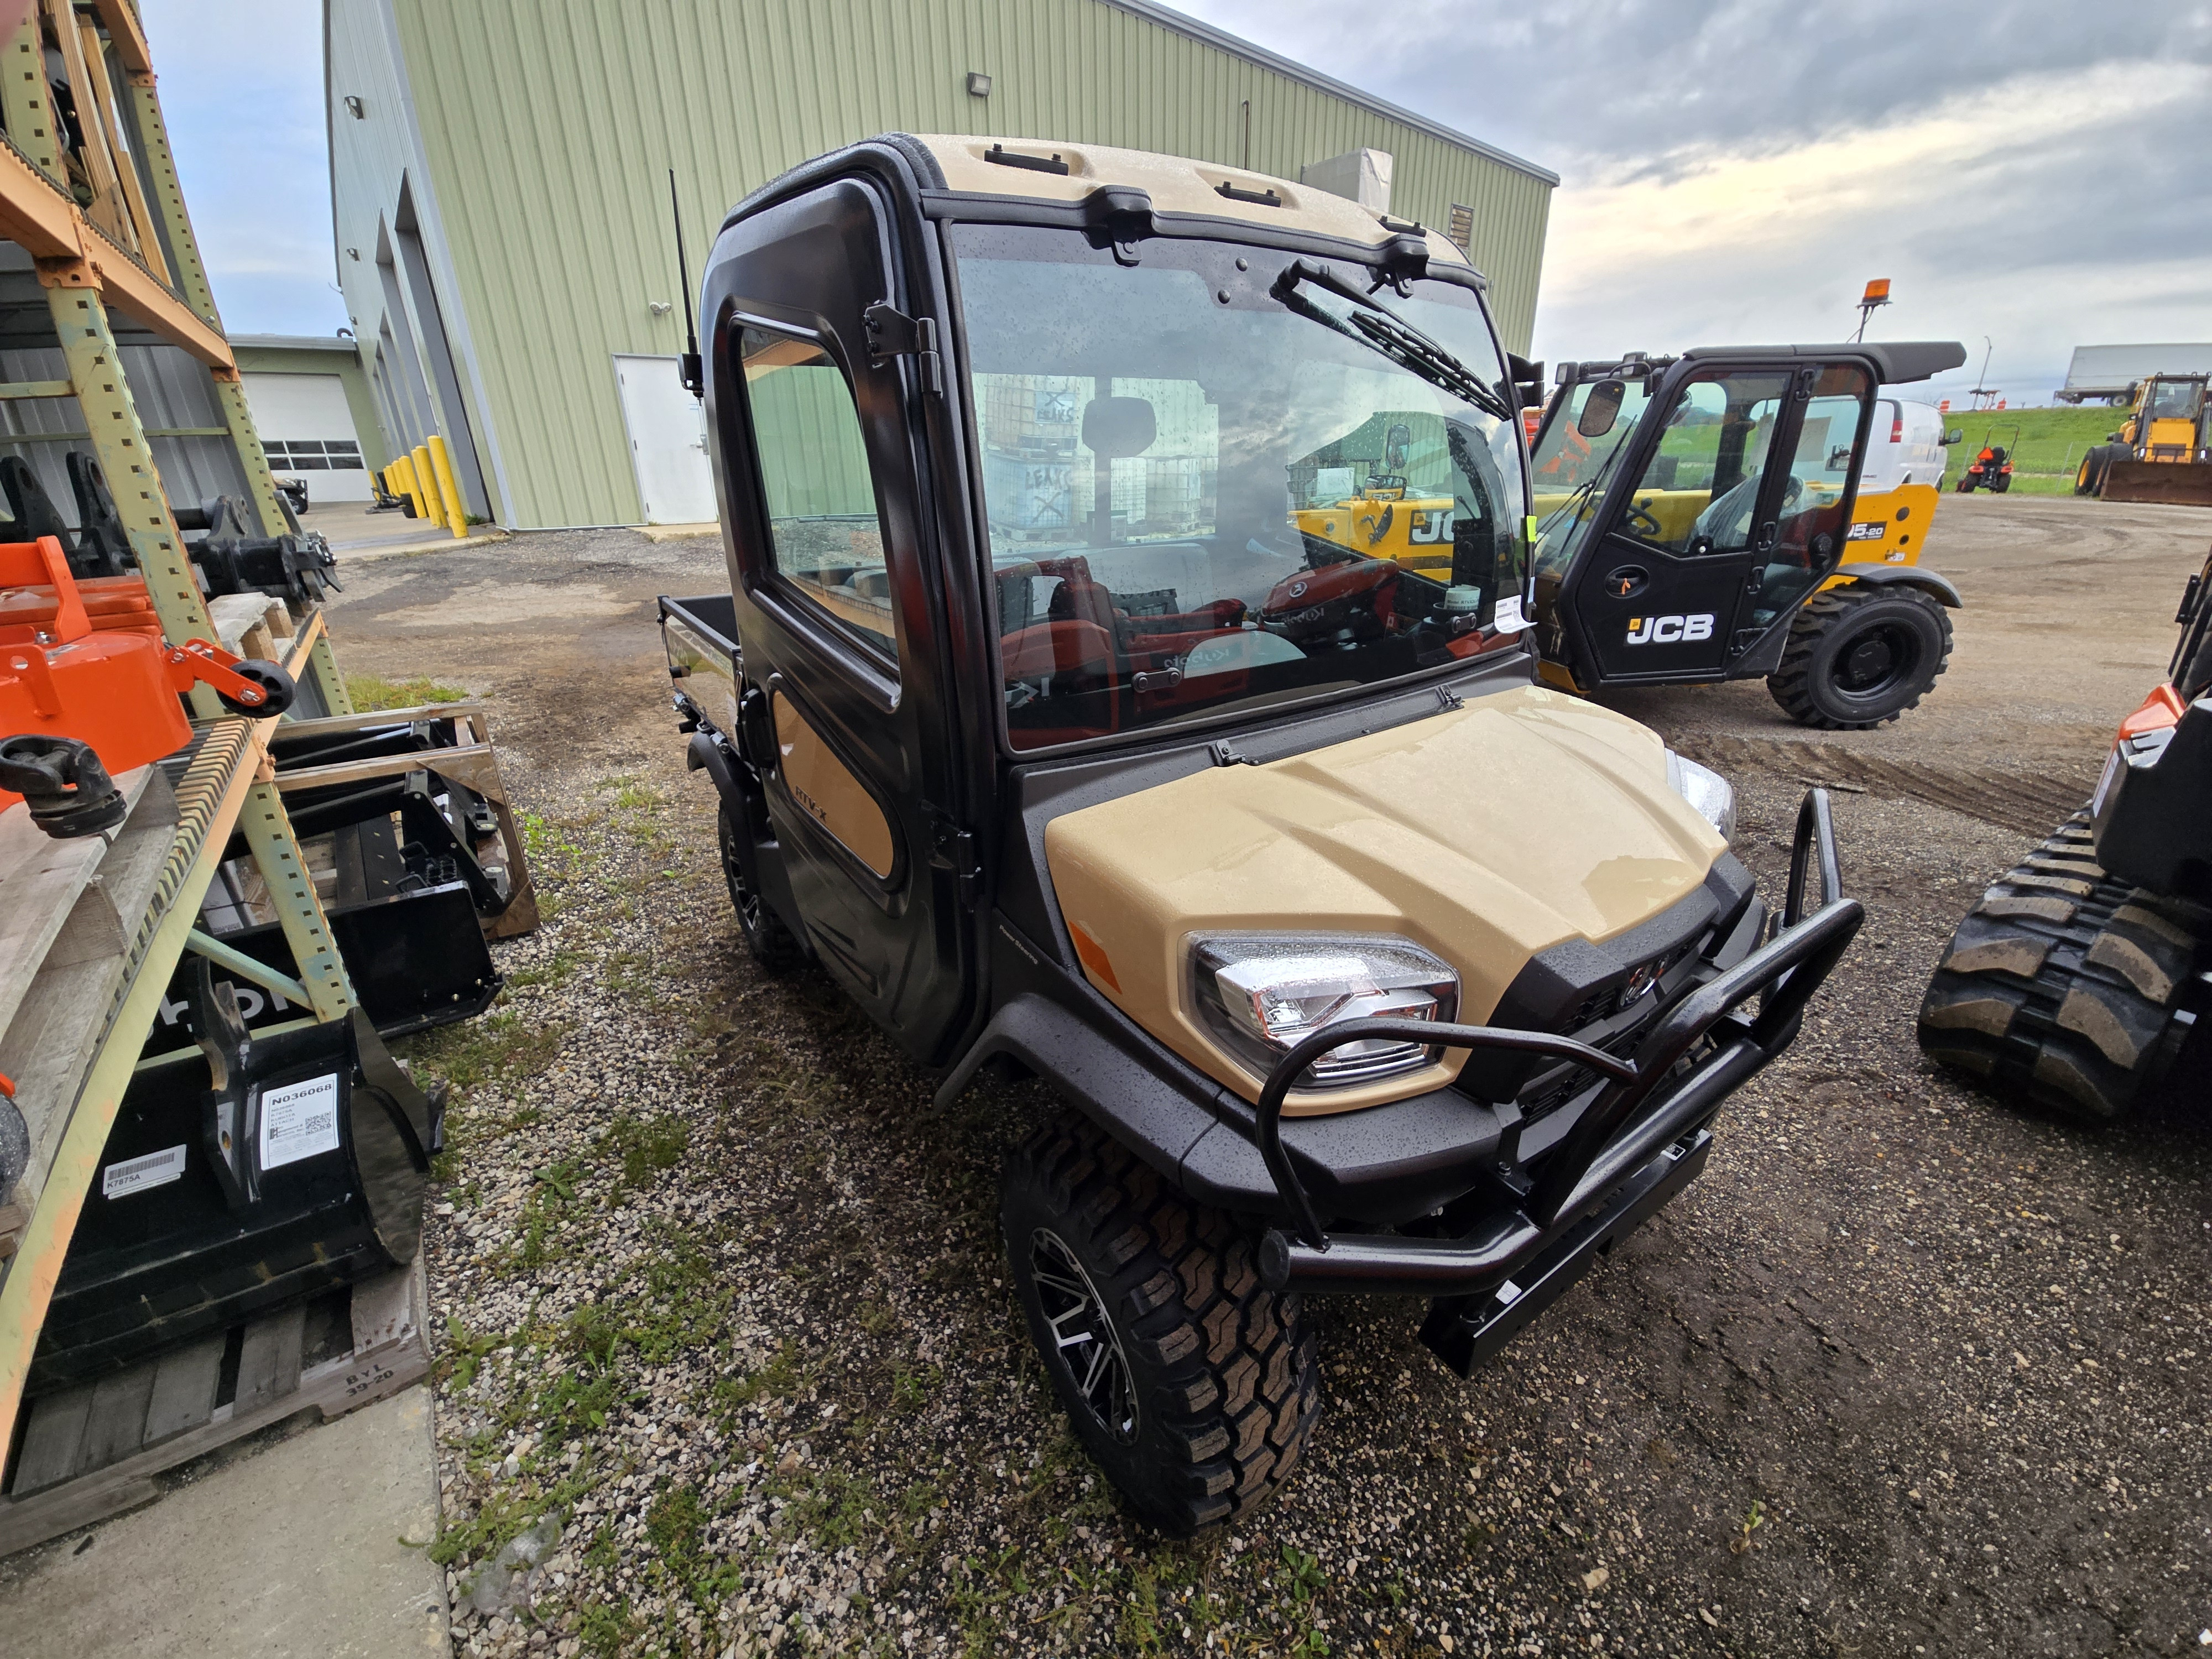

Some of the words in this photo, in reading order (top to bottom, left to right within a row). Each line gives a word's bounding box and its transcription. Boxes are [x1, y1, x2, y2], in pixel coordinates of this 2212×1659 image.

[1627, 614, 1714, 644] JCB
[796, 785, 827, 824] RTV-X
[272, 1083, 332, 1105] N036068
[107, 1173, 140, 1189] K7875A
